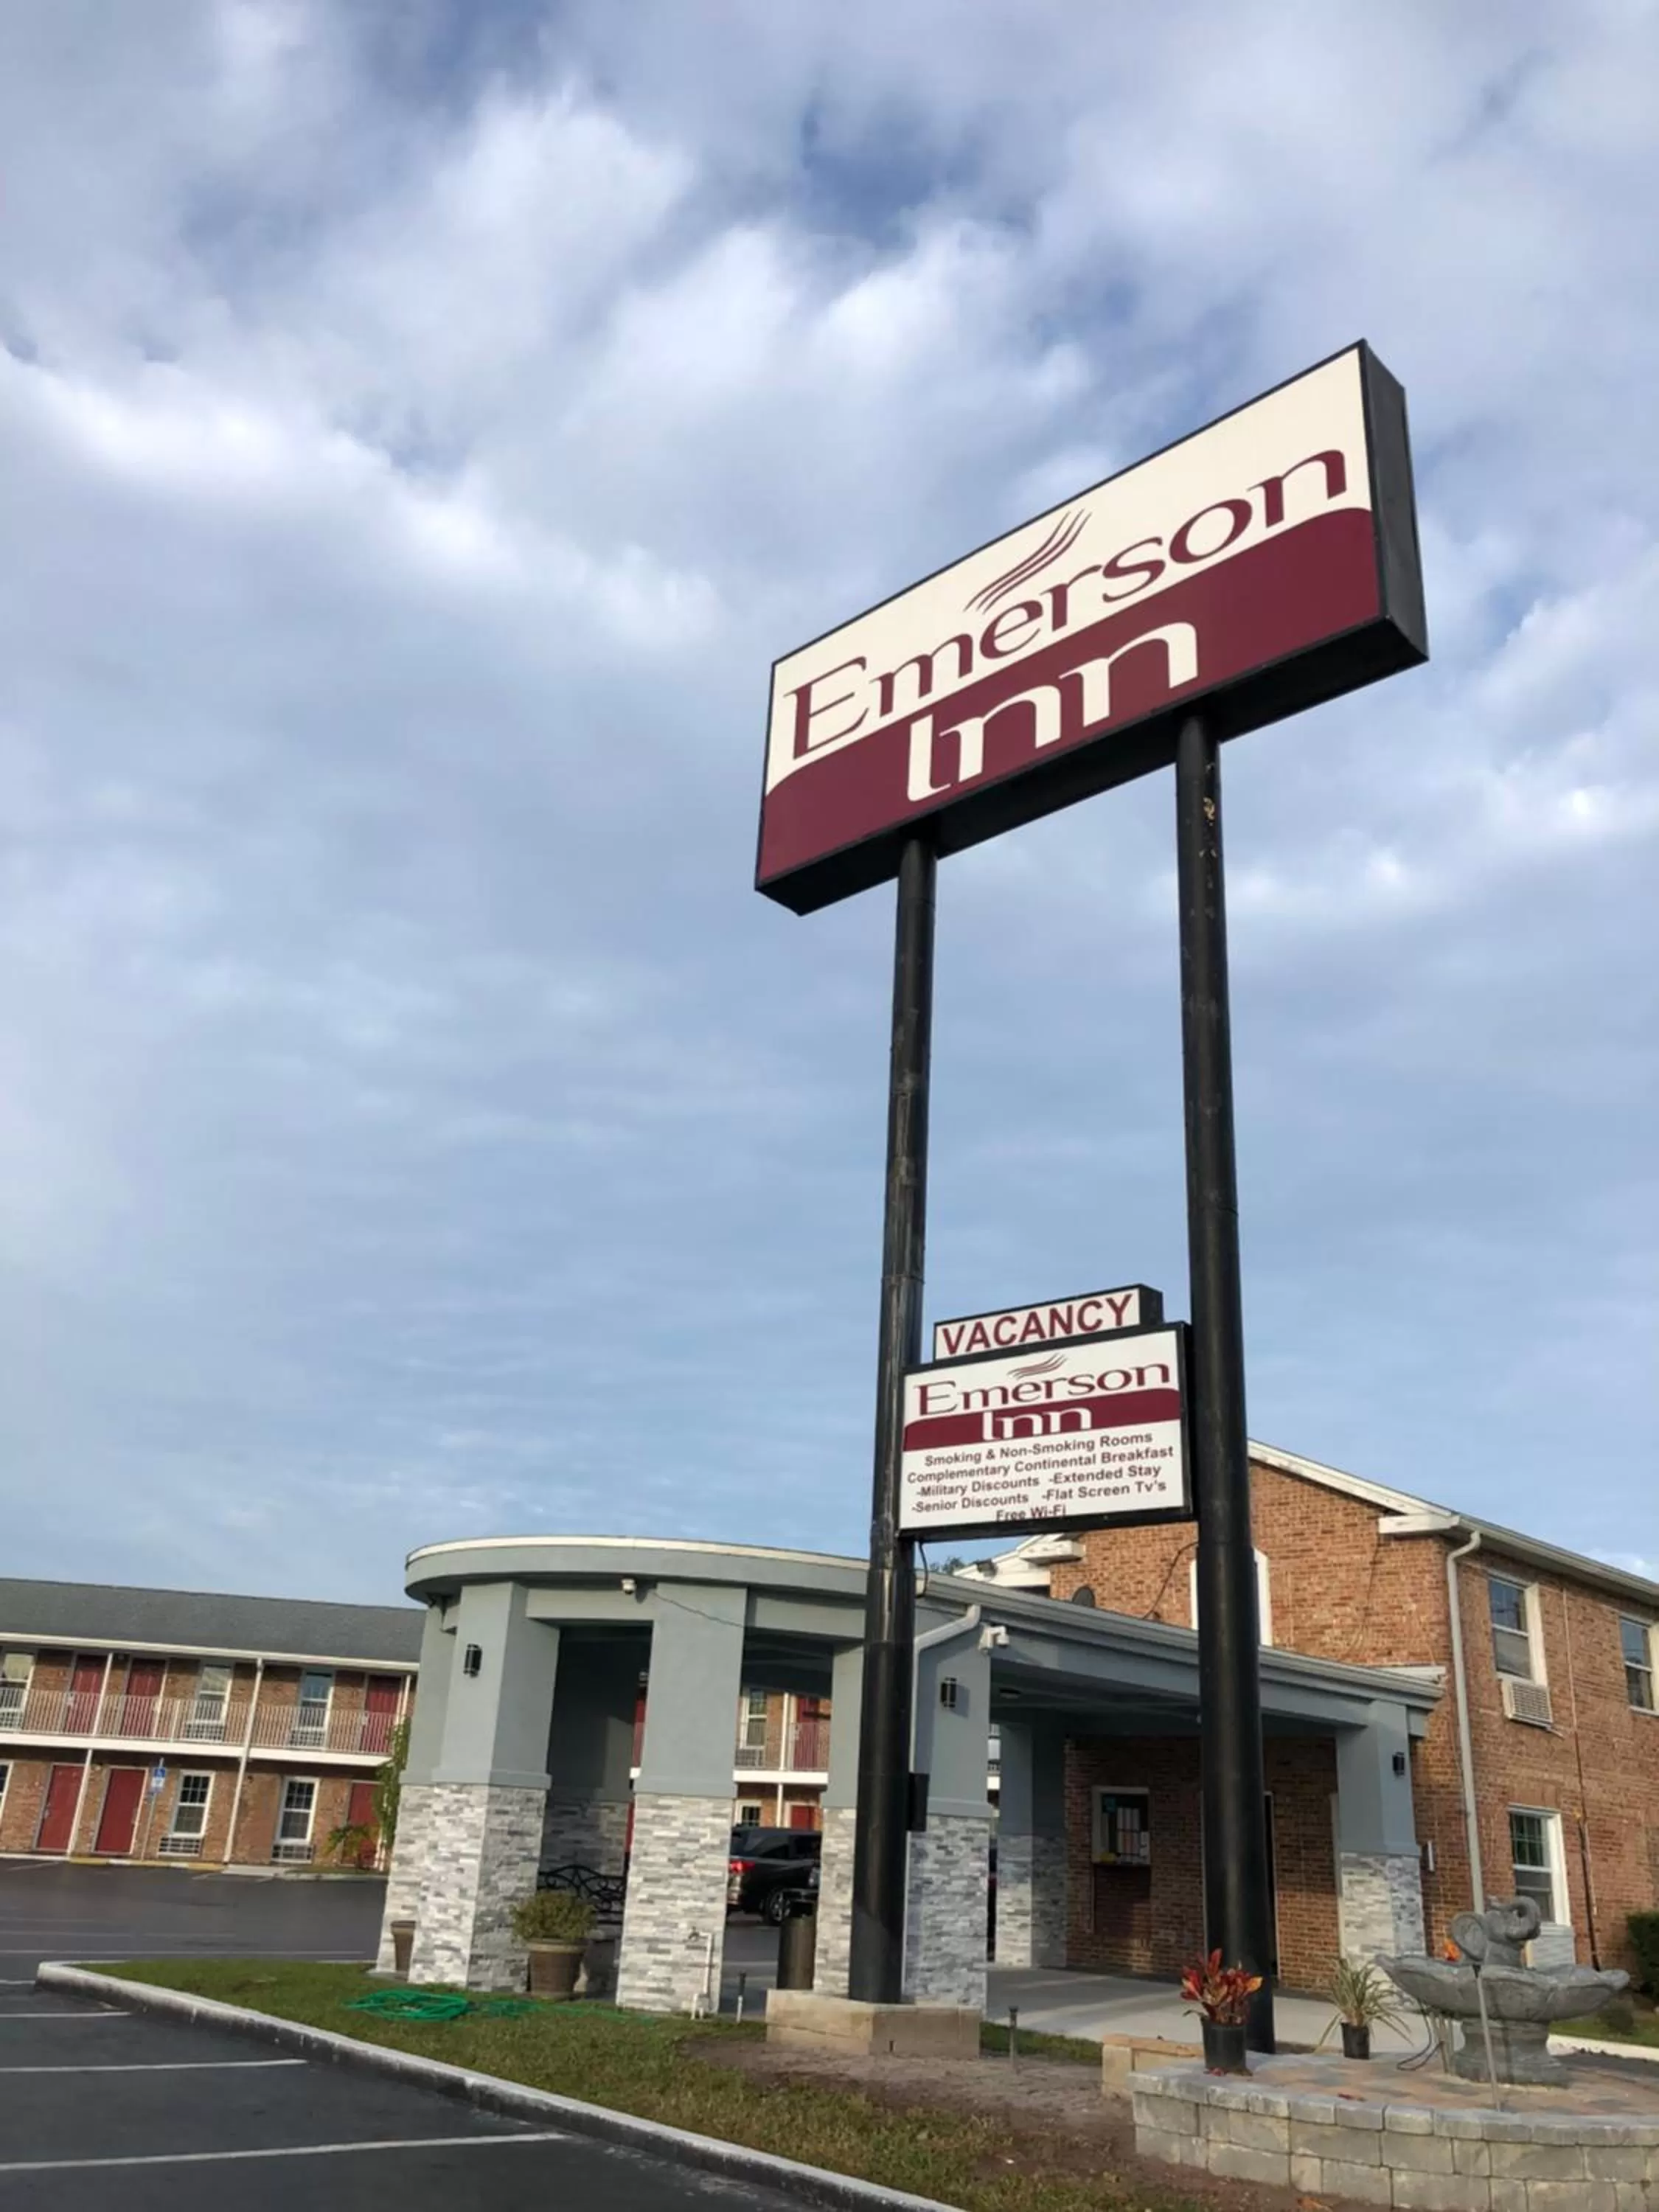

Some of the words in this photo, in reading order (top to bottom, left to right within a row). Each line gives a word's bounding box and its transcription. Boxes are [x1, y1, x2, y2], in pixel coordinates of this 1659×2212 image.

[782, 448, 1348, 761] Emerson
[906, 622, 1198, 802] Inn
[942, 1293, 1133, 1355] VACANCY
[914, 1363, 1170, 1416] Emerson
[982, 1405, 1092, 1441] Inn
[907, 1463, 1011, 1484] Complementary
[1014, 1453, 1096, 1473] Continental
[1101, 1445, 1174, 1464] Breakfast
[924, 1451, 982, 1467] Smoking
[985, 1448, 996, 1461] &
[1000, 1438, 1096, 1458] Non-Smoking
[1099, 1433, 1153, 1447] Rooms
[911, 1499, 958, 1513] -Senior
[961, 1493, 1029, 1509] Discounts
[1041, 1487, 1074, 1502] -Flat
[1077, 1484, 1130, 1498] Screen
[1135, 1480, 1167, 1494] Tv's
[915, 1483, 968, 1498] -Military
[971, 1476, 1040, 1492] Discounts
[1048, 1467, 1123, 1484] -Extended
[1127, 1464, 1162, 1478] Stay
[996, 1509, 1026, 1523] Free
